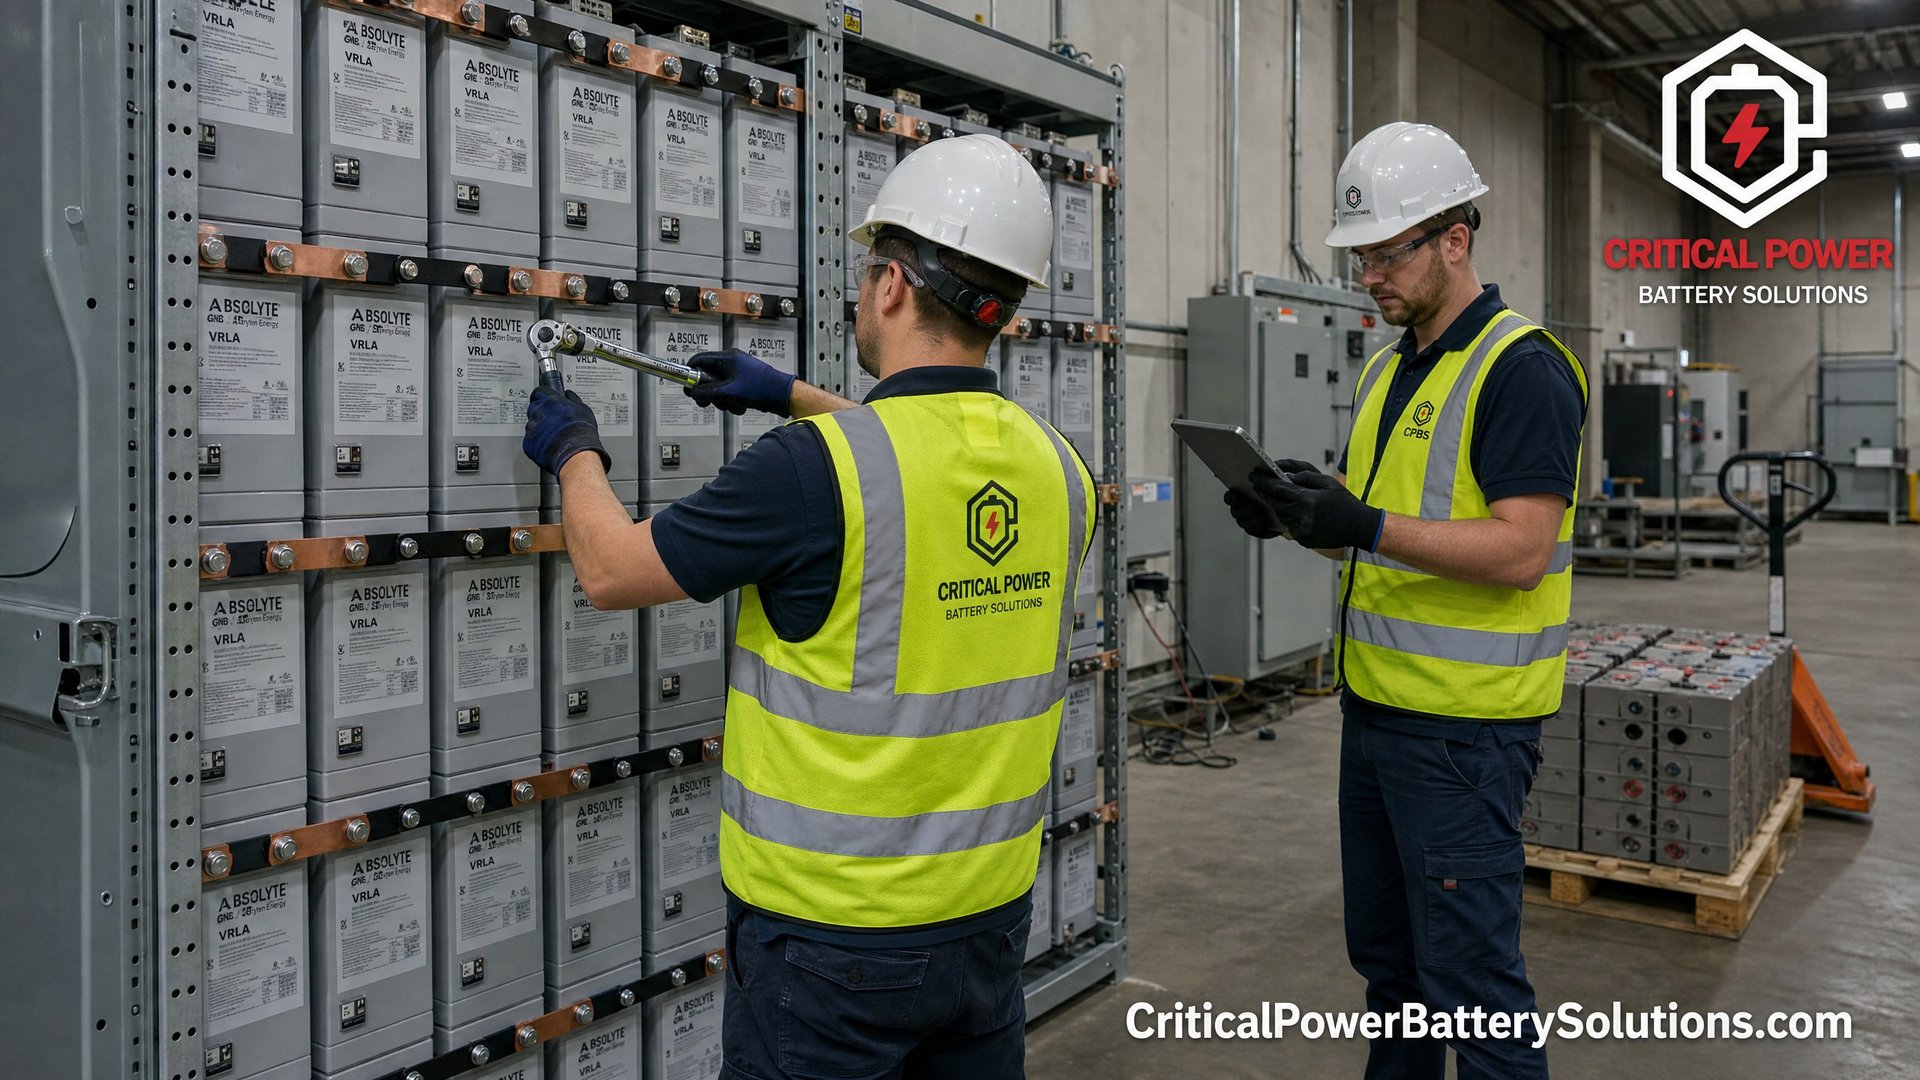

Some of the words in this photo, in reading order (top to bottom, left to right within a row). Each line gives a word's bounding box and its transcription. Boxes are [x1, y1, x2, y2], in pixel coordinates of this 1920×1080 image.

[202, 10, 235, 29] VRLA
[345, 51, 373, 67] VRLA
[465, 88, 490, 101] VRLA
[572, 113, 594, 125] VRLA
[667, 133, 686, 145] VRLA
[748, 151, 766, 161] VRLA
[208, 331, 240, 343] VRLA
[350, 339, 378, 350] VRLA
[468, 346, 493, 356] VRLA
[1404, 427, 1430, 439] CPBS
[938, 577, 1001, 601] CRITICAL
[1004, 572, 1050, 593] POWER
[349, 603, 364, 612] GNB
[574, 599, 592, 608] VRL
[946, 605, 988, 620] BATTERY
[991, 598, 1042, 613] SOLUTIONS
[468, 607, 493, 618] VRLA
[212, 617, 229, 627] GNB
[263, 613, 282, 622] Energy
[349, 618, 378, 629] VRLA
[213, 633, 245, 645] VRLA
[670, 807, 690, 819] VRLA
[576, 829, 599, 842] VRLA
[470, 856, 495, 870] VRLA
[352, 887, 380, 903] VRLA
[266, 900, 287, 912] Energy
[218, 924, 250, 941] VRLA
[674, 1023, 694, 1037] VRLA
[579, 1061, 601, 1077] VRLA
